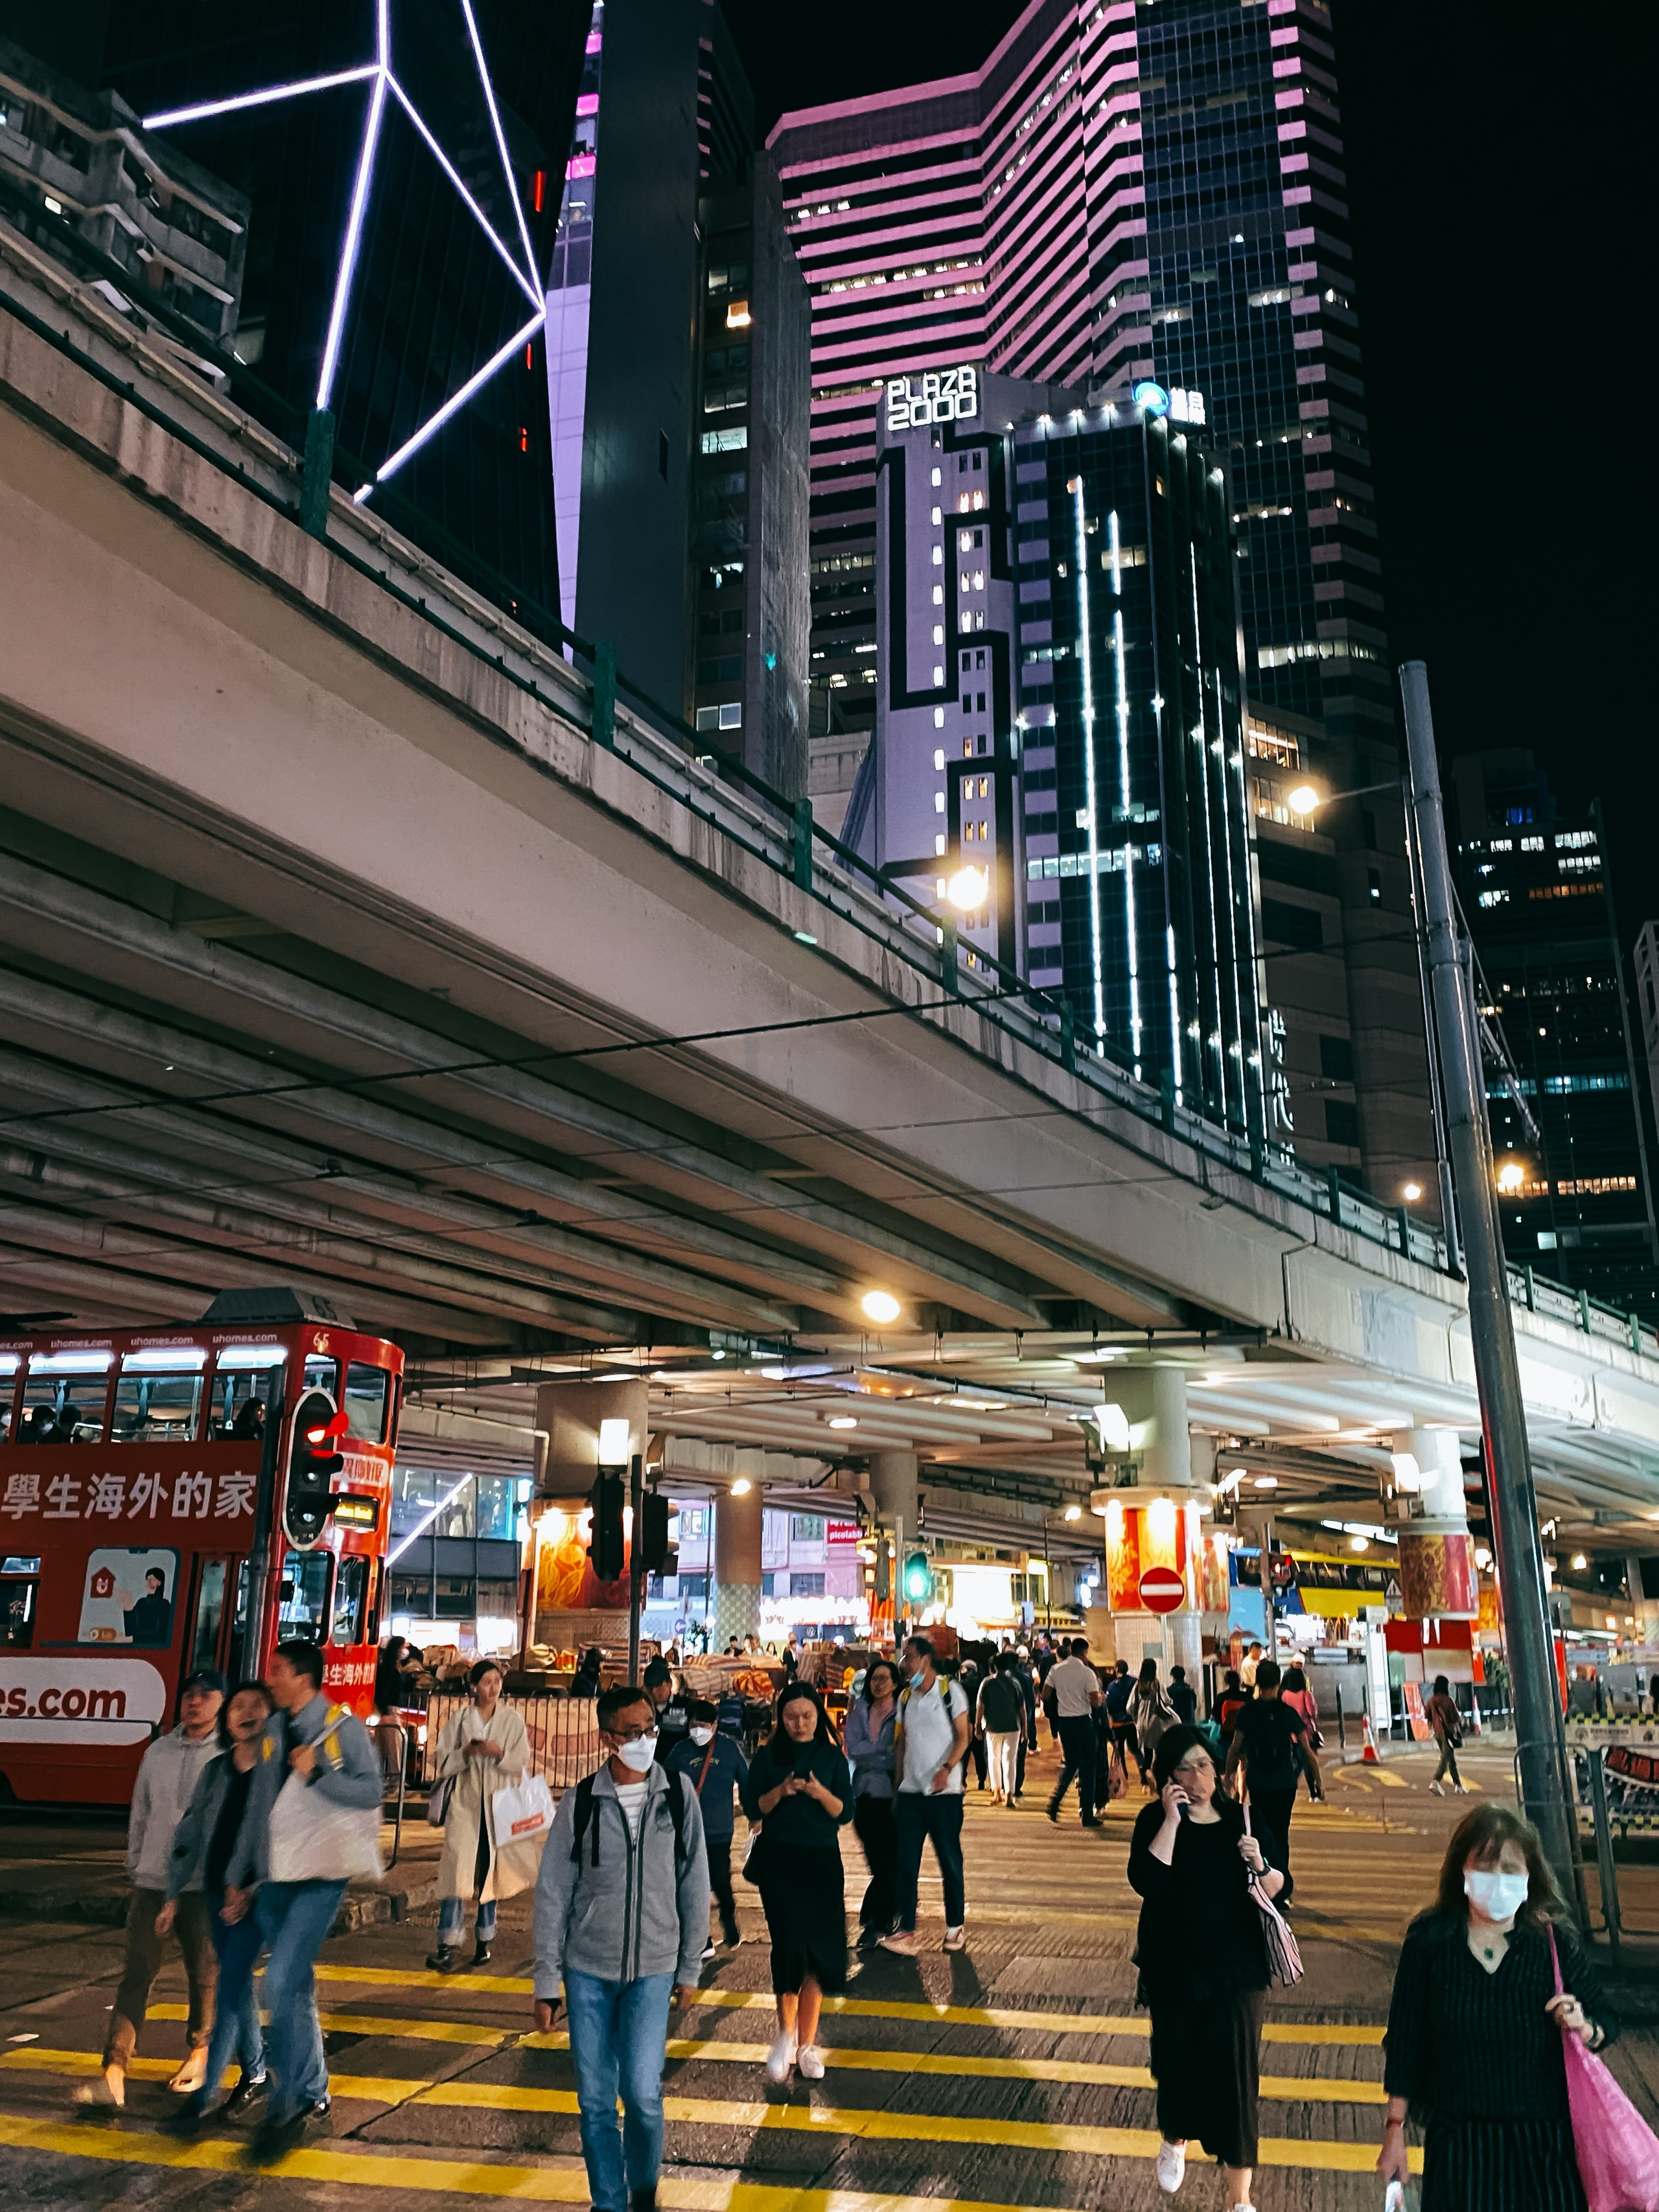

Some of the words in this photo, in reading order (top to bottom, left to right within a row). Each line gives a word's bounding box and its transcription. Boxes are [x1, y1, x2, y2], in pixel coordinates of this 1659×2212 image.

[888, 365, 977, 406] PLAZA
[888, 391, 977, 431] 2000
[51, 1339, 112, 1348] uhomes.com
[131, 1336, 193, 1346] uhomes.com
[213, 1333, 277, 1344] uhomes.com
[313, 1332, 329, 1348] 65
[1, 1470, 257, 1520] 學生海外的家
